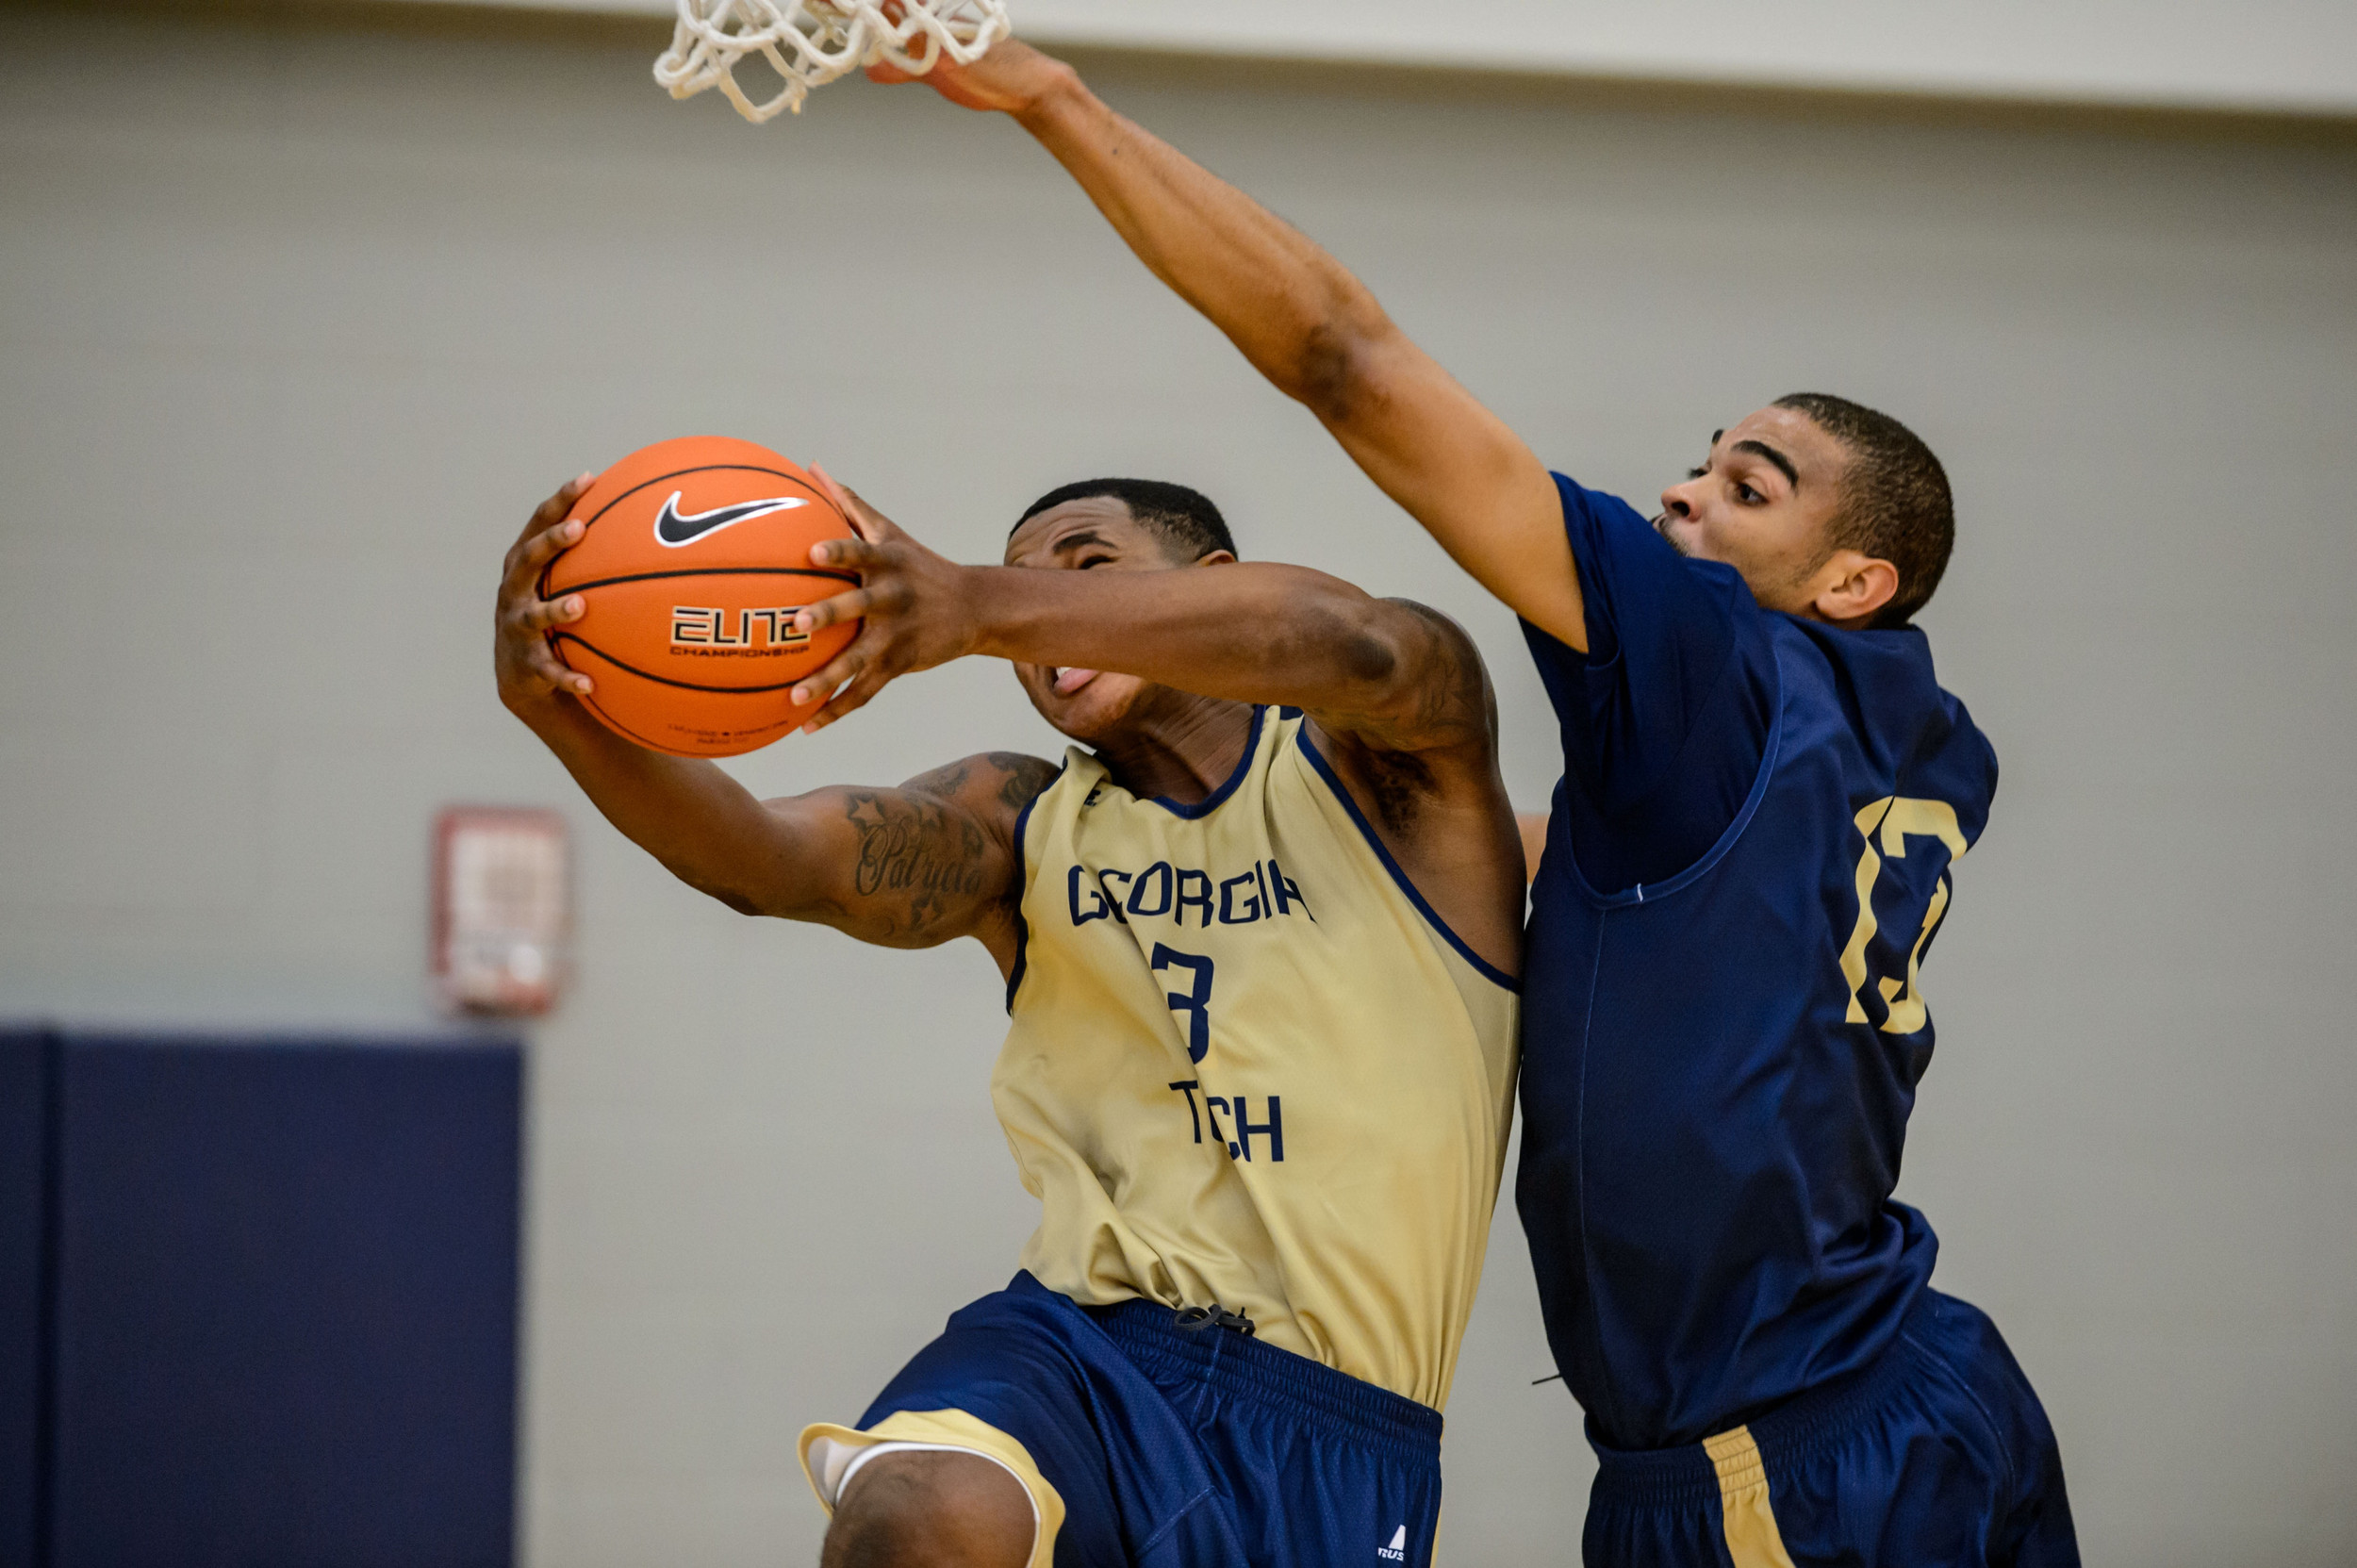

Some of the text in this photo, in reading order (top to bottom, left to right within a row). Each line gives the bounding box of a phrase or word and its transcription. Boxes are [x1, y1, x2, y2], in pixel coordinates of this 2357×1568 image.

[669, 645, 810, 658] CHAMPIONSHIP
[670, 605, 811, 649] ELITE
[1067, 859, 1317, 929] GEORGIA
[1151, 942, 1214, 1065] 3
[1168, 1081, 1284, 1163] TCH
